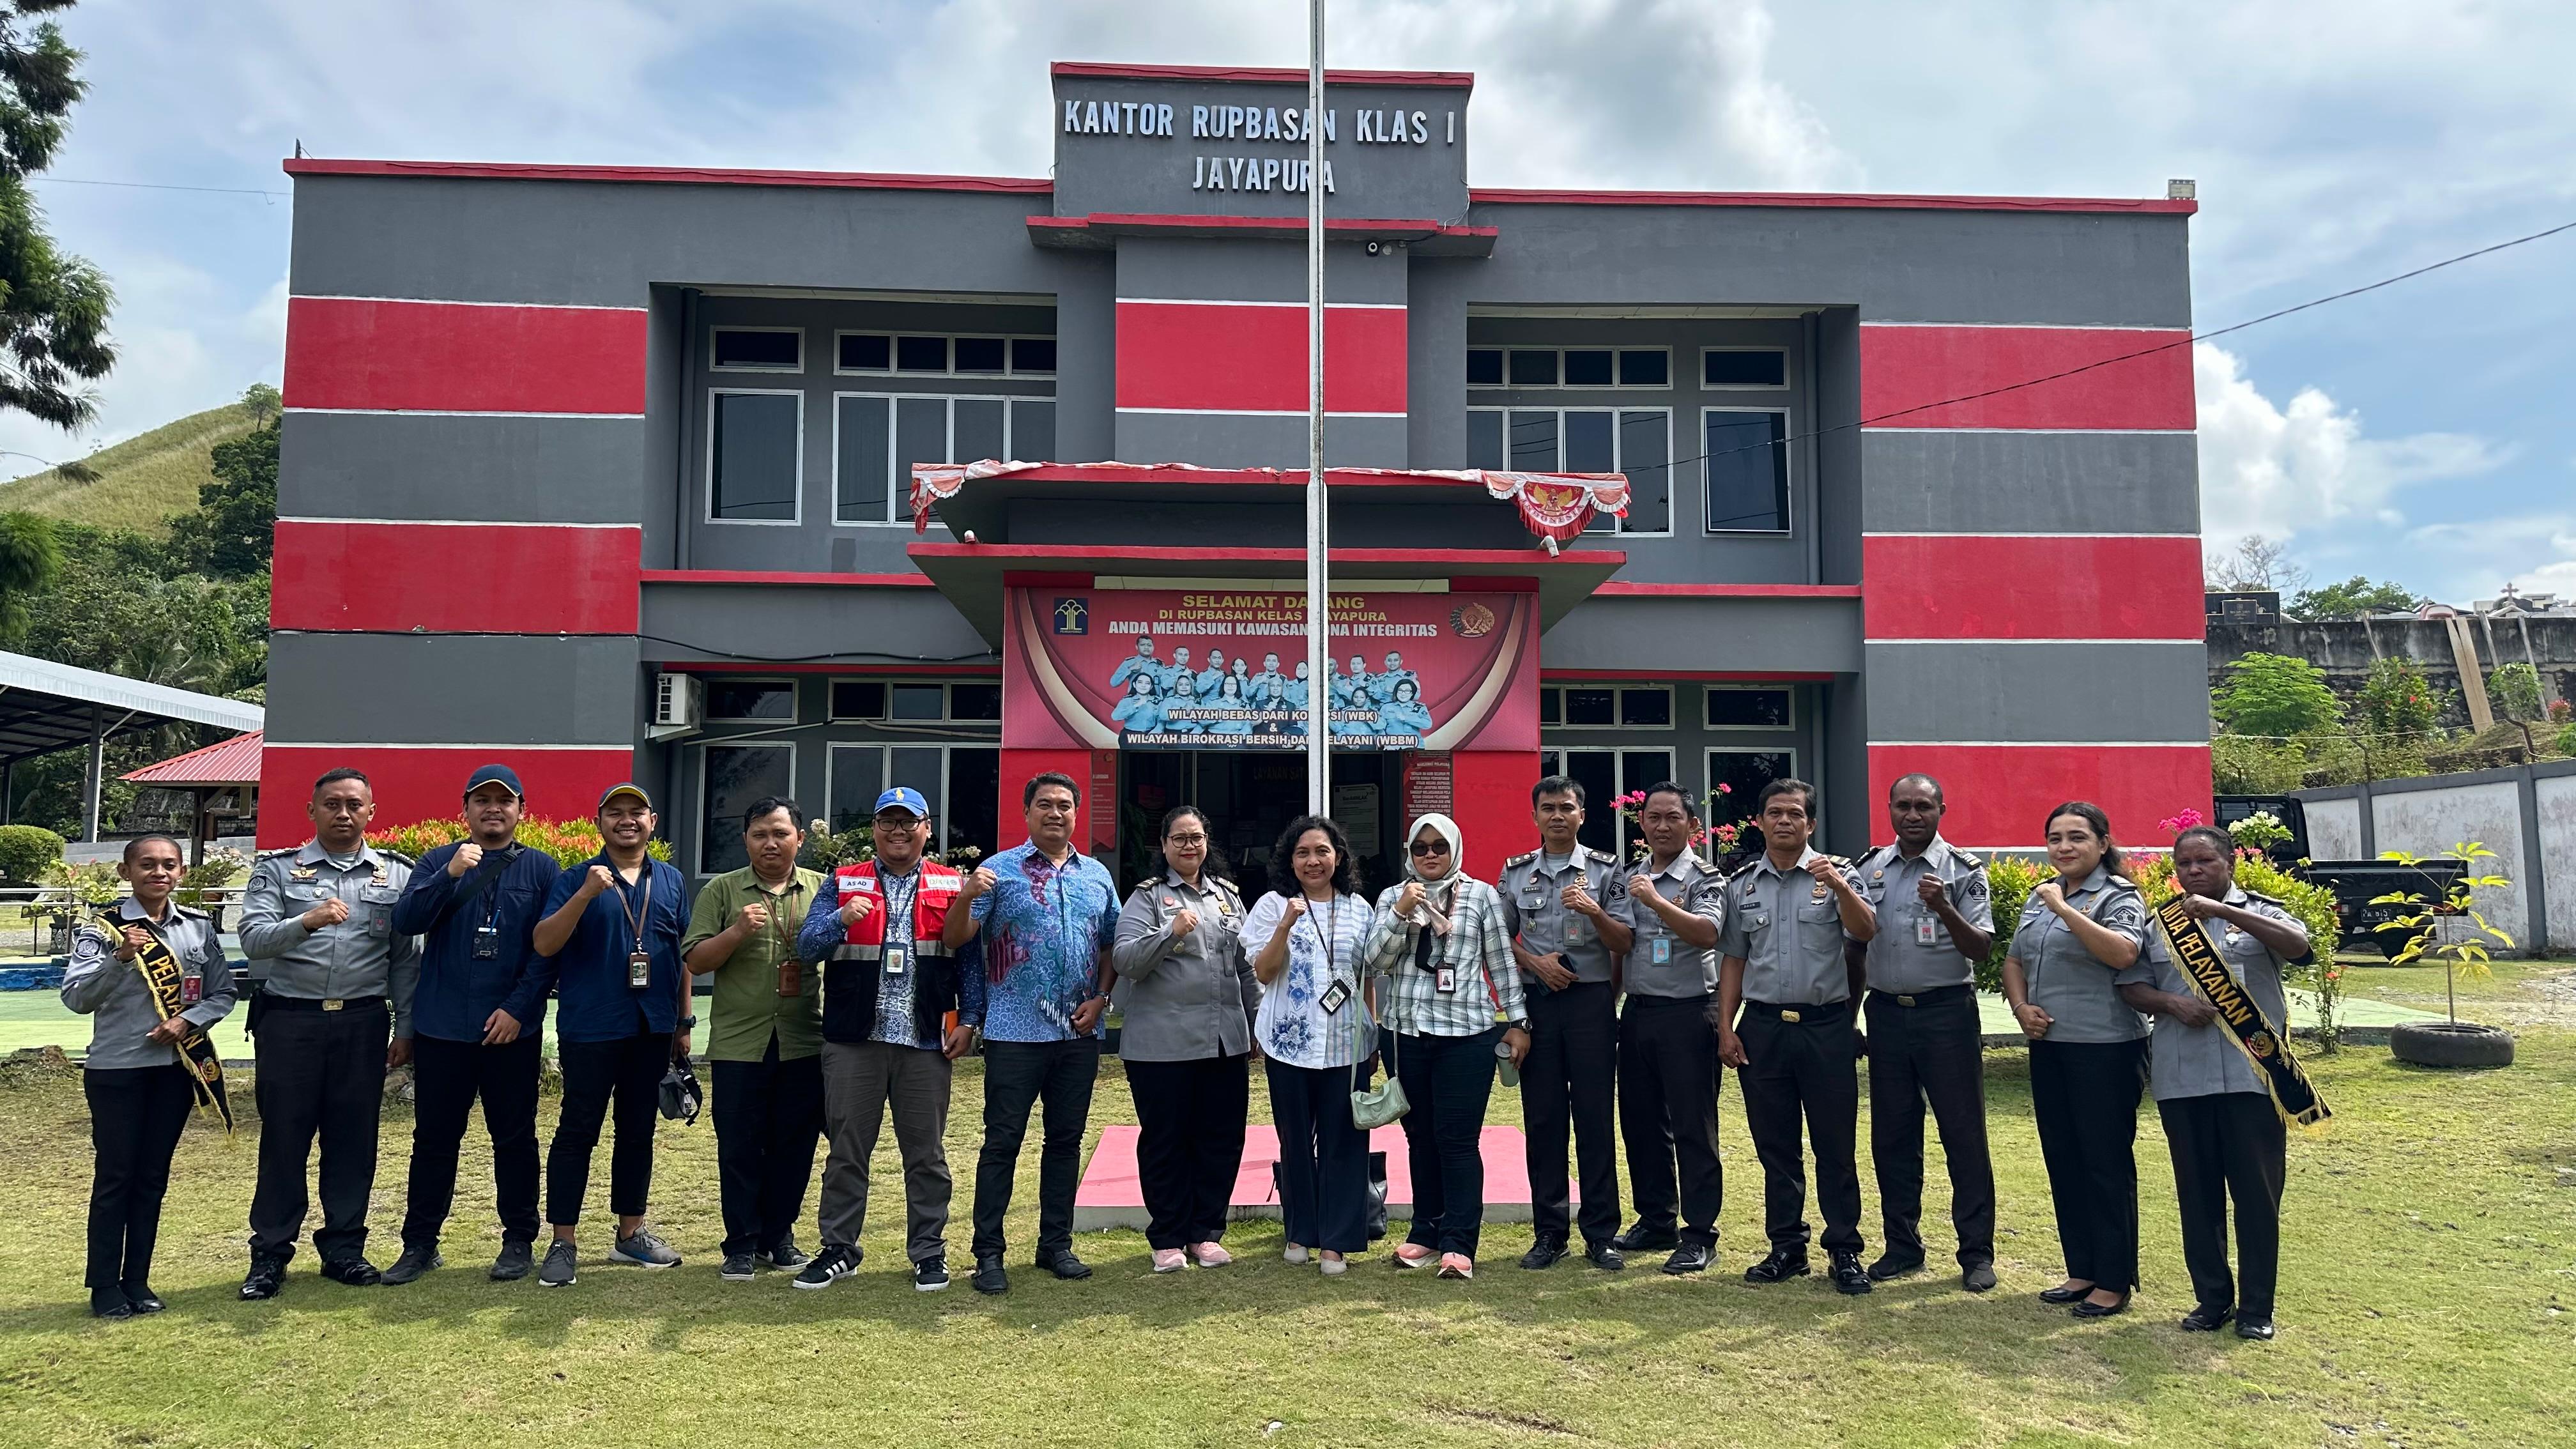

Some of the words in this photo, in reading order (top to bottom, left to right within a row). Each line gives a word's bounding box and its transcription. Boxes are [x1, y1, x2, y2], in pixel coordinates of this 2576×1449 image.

[1064, 100, 1173, 137] KANTOR
[1192, 104, 1335, 142] RUPBASAN
[1356, 109, 1428, 144] KLAS
[1447, 111, 1454, 144] I
[1192, 156, 1335, 192] JAYAPURA
[1522, 498, 1585, 524] INDONESIA
[1183, 595, 1278, 608] SELAMAT
[1284, 596, 1365, 609] DAANG
[1159, 610, 1173, 620] DI
[1177, 610, 1253, 620] RUPBASAN
[1257, 611, 1303, 621] KELAS
[1328, 611, 1388, 622] YAPURA
[1108, 621, 1149, 634] ANDA
[1153, 622, 1232, 635] MEMASUKI
[1236, 622, 1308, 636] KAWASAN
[1353, 624, 1438, 637] INTEGRITAS
[1168, 709, 1219, 720] WILAYAH
[1222, 710, 1259, 720] BEBAS
[1262, 710, 1289, 721] DARI
[1292, 710, 1341, 721] KOSI
[1344, 710, 1379, 723] (WBK)
[1269, 723, 1278, 732] &
[1127, 734, 1178, 744] WILAYAH
[1181, 735, 1243, 744] BIROKRASI
[1246, 735, 1287, 744] BERSIH
[1329, 735, 1373, 746] ELAYANI
[1376, 735, 1419, 746] (WBBM)
[2159, 900, 2191, 937] DUTA
[2175, 931, 2253, 1027] PELAYANAN
[148, 955, 205, 1050] PELAYAN
